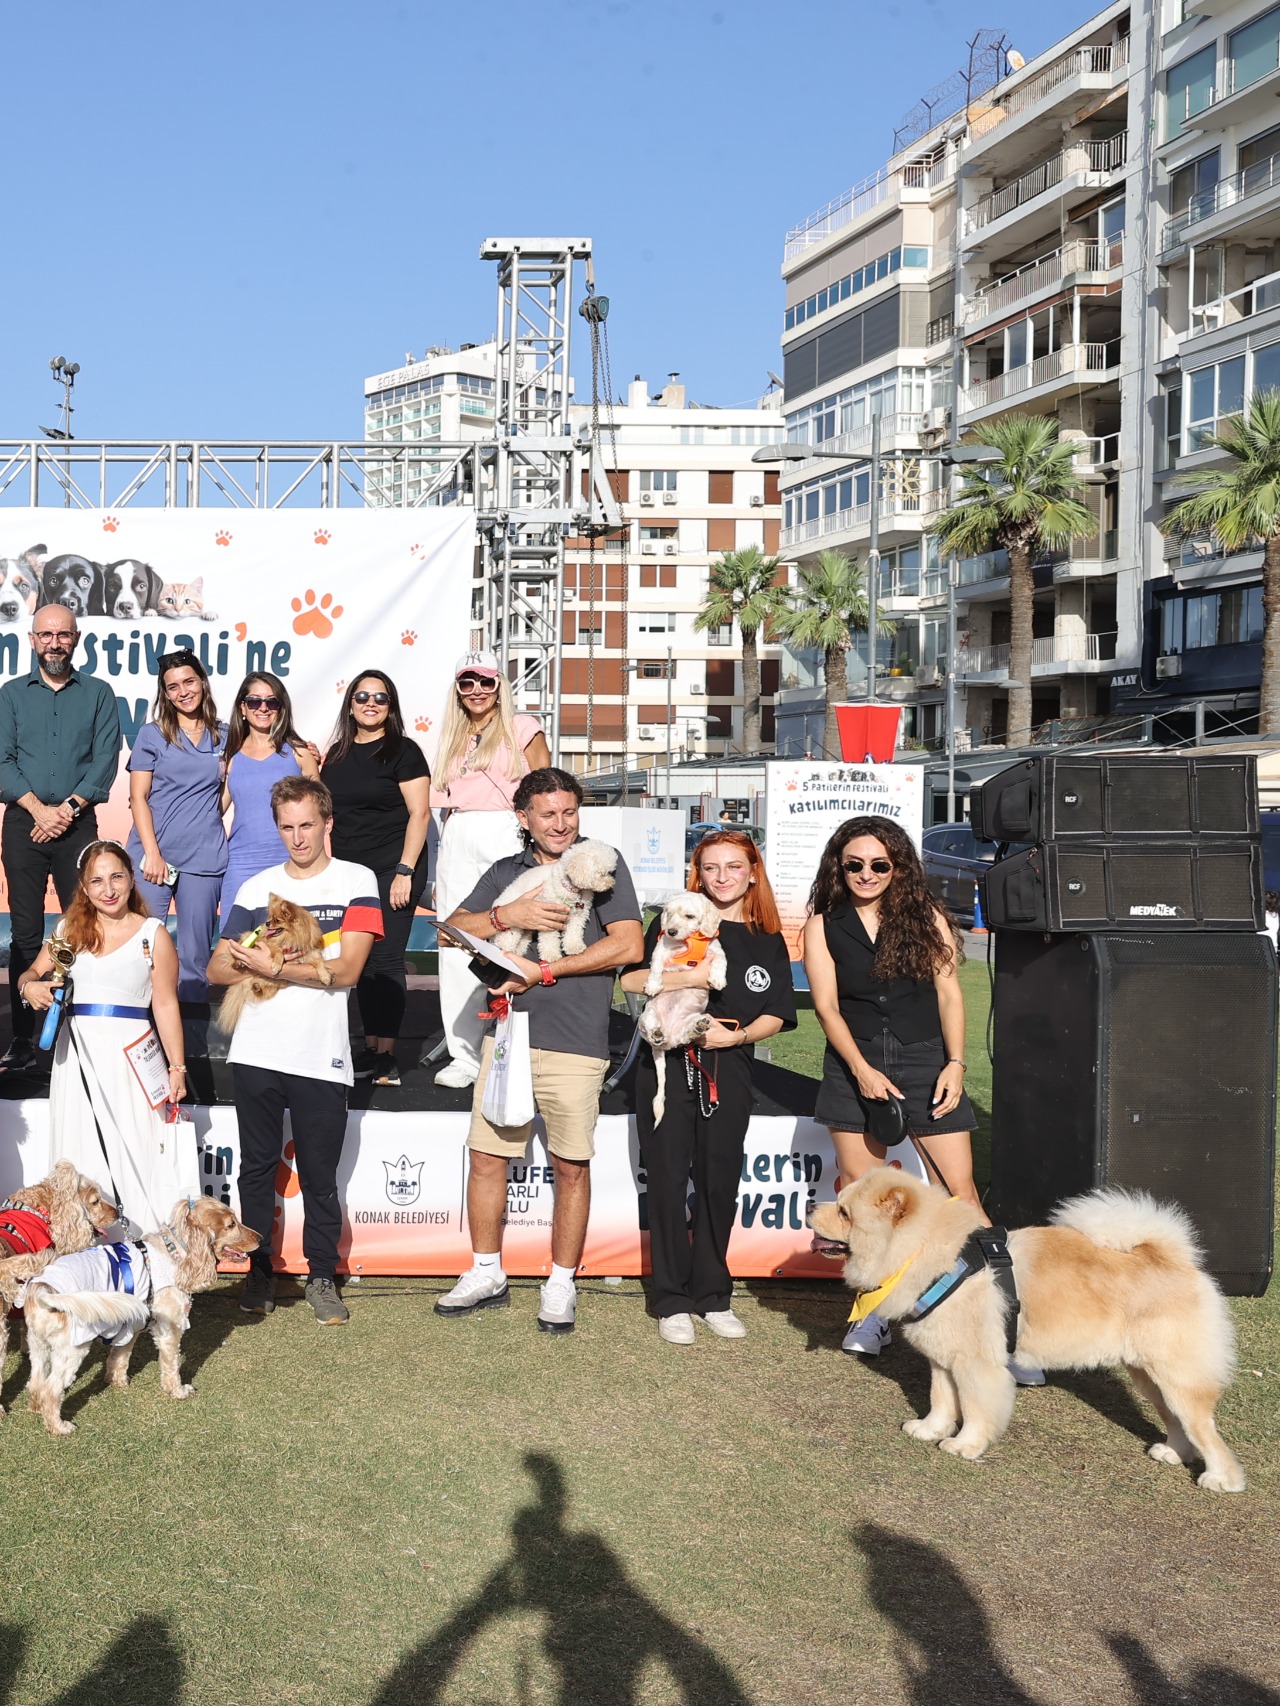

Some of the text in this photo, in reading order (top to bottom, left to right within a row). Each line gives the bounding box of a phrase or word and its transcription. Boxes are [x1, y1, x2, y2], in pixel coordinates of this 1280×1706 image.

[398, 364, 430, 385] PALAS
[1111, 674, 1138, 687] AKAY
[1130, 904, 1177, 917] MEDYATEK
[741, 1152, 823, 1183] lerin
[506, 1185, 539, 1198] ARLI
[354, 1209, 451, 1225] KONAK BELEDİYESİ
